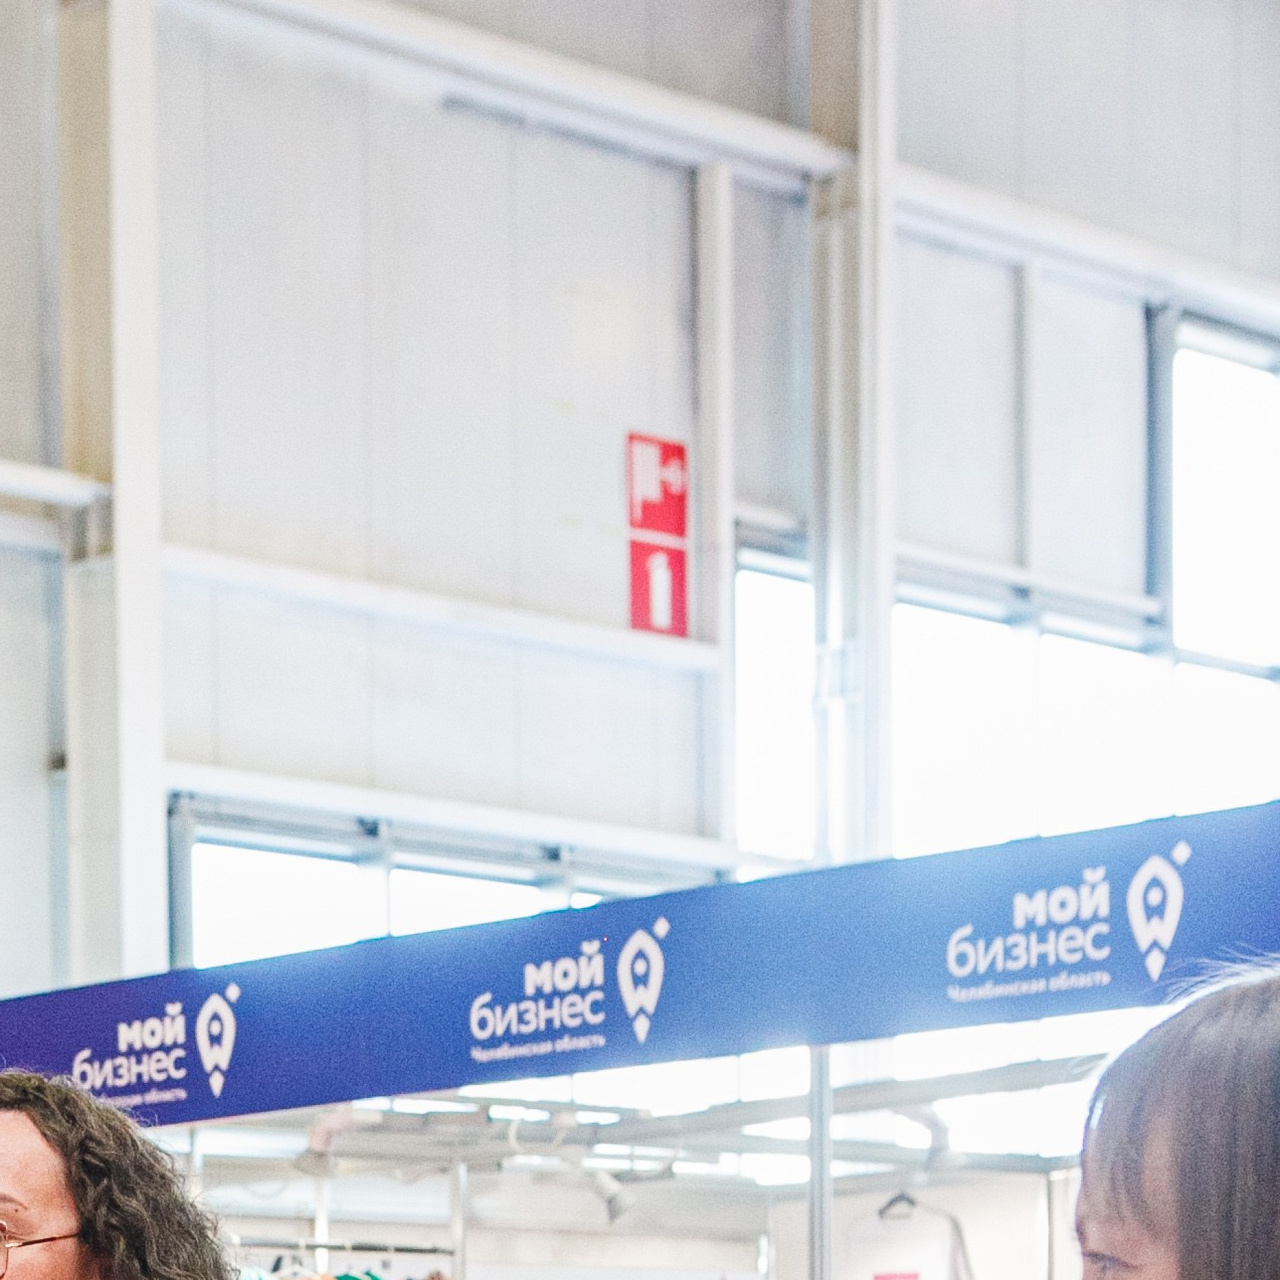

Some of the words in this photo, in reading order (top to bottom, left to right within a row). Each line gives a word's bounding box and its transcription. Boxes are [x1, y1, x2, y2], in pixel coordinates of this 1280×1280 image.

[947, 922, 1110, 977] бизнес
[471, 990, 605, 1039] бизнес
[72, 1047, 187, 1089] бизнес
